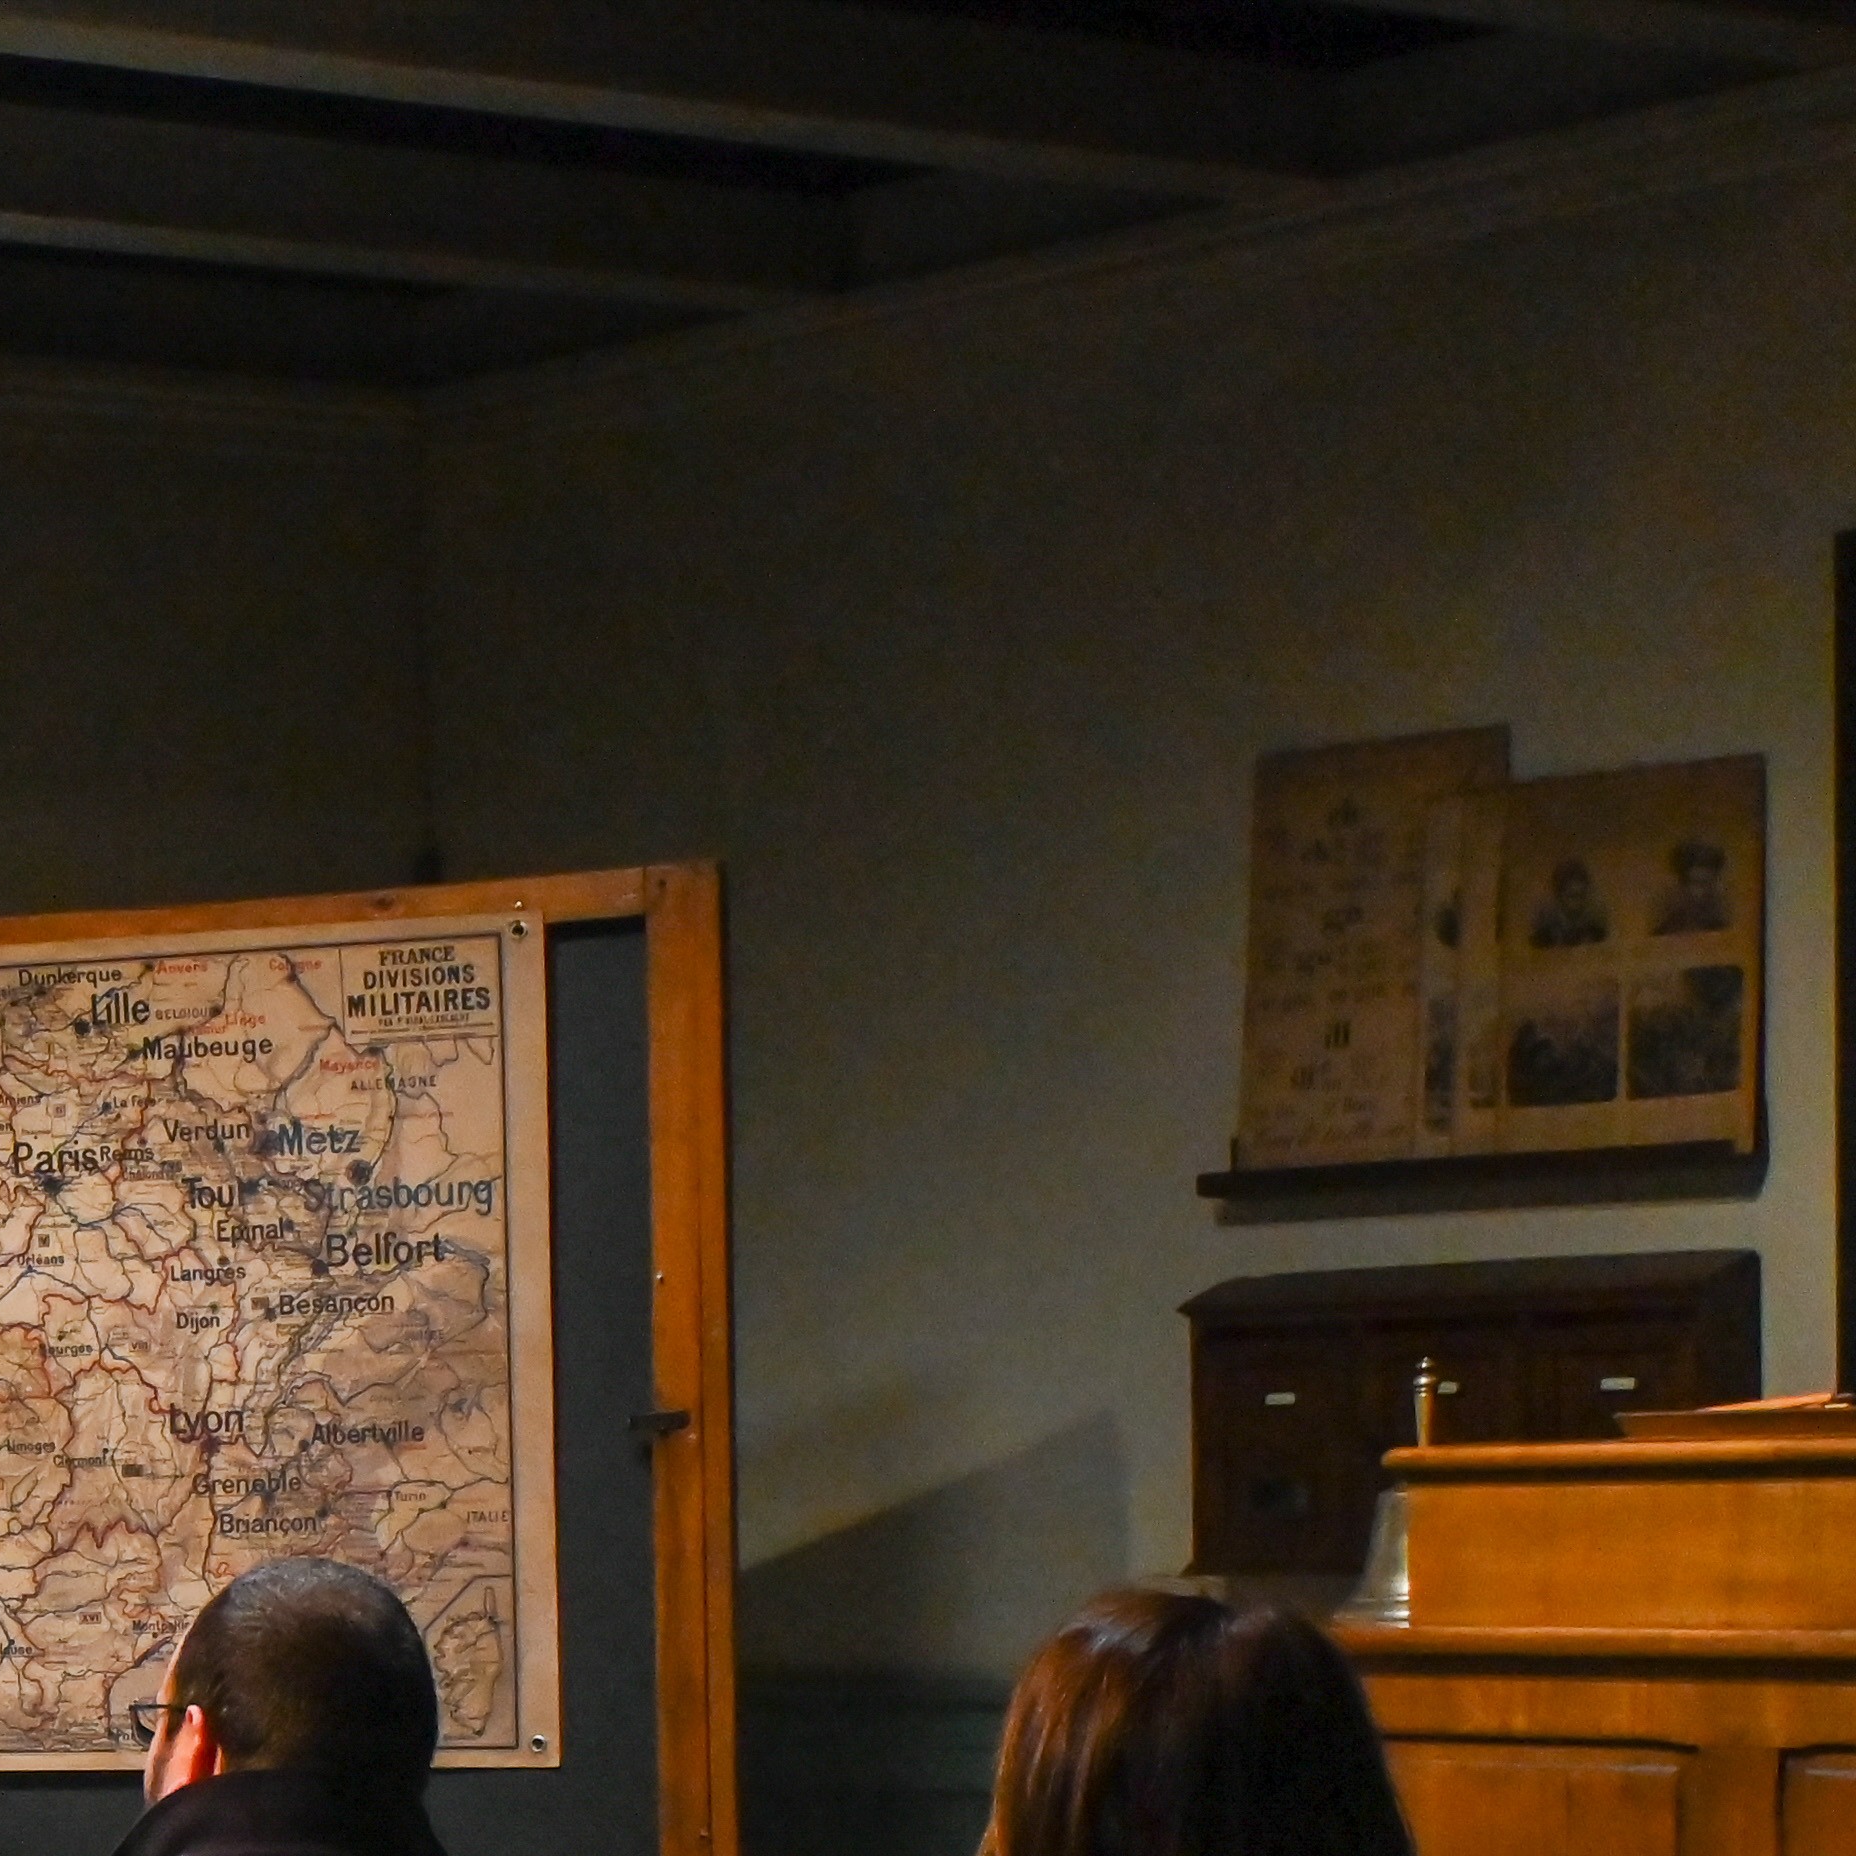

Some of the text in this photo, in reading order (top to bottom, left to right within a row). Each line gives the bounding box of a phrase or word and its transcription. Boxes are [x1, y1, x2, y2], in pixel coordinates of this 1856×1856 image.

[378, 945, 456, 967] FRANCE
[18, 967, 123, 994] Dunkerque
[362, 964, 476, 990] DIVISIONS
[90, 992, 151, 1026] Lille
[154, 1005, 219, 1021] BELGIQU
[347, 986, 491, 1019] MILITAIRES
[141, 1036, 274, 1065] Maubeuge
[162, 1118, 252, 1144] Verdun
[277, 1119, 363, 1157] Metz
[12, 1142, 102, 1176] Paris
[303, 1176, 495, 1216] Strasbourg
[326, 1231, 446, 1268] Belfort
[170, 1263, 246, 1286] Langres
[279, 1294, 395, 1317] Besançon
[176, 1312, 221, 1334] Dijon
[40, 1343, 93, 1357] ourges
[168, 1404, 245, 1441] Lyon
[310, 1421, 425, 1446] Albertville
[52, 1453, 108, 1468] Clermont
[191, 1471, 302, 1495] Grenoble
[219, 1513, 318, 1536] Briançon
